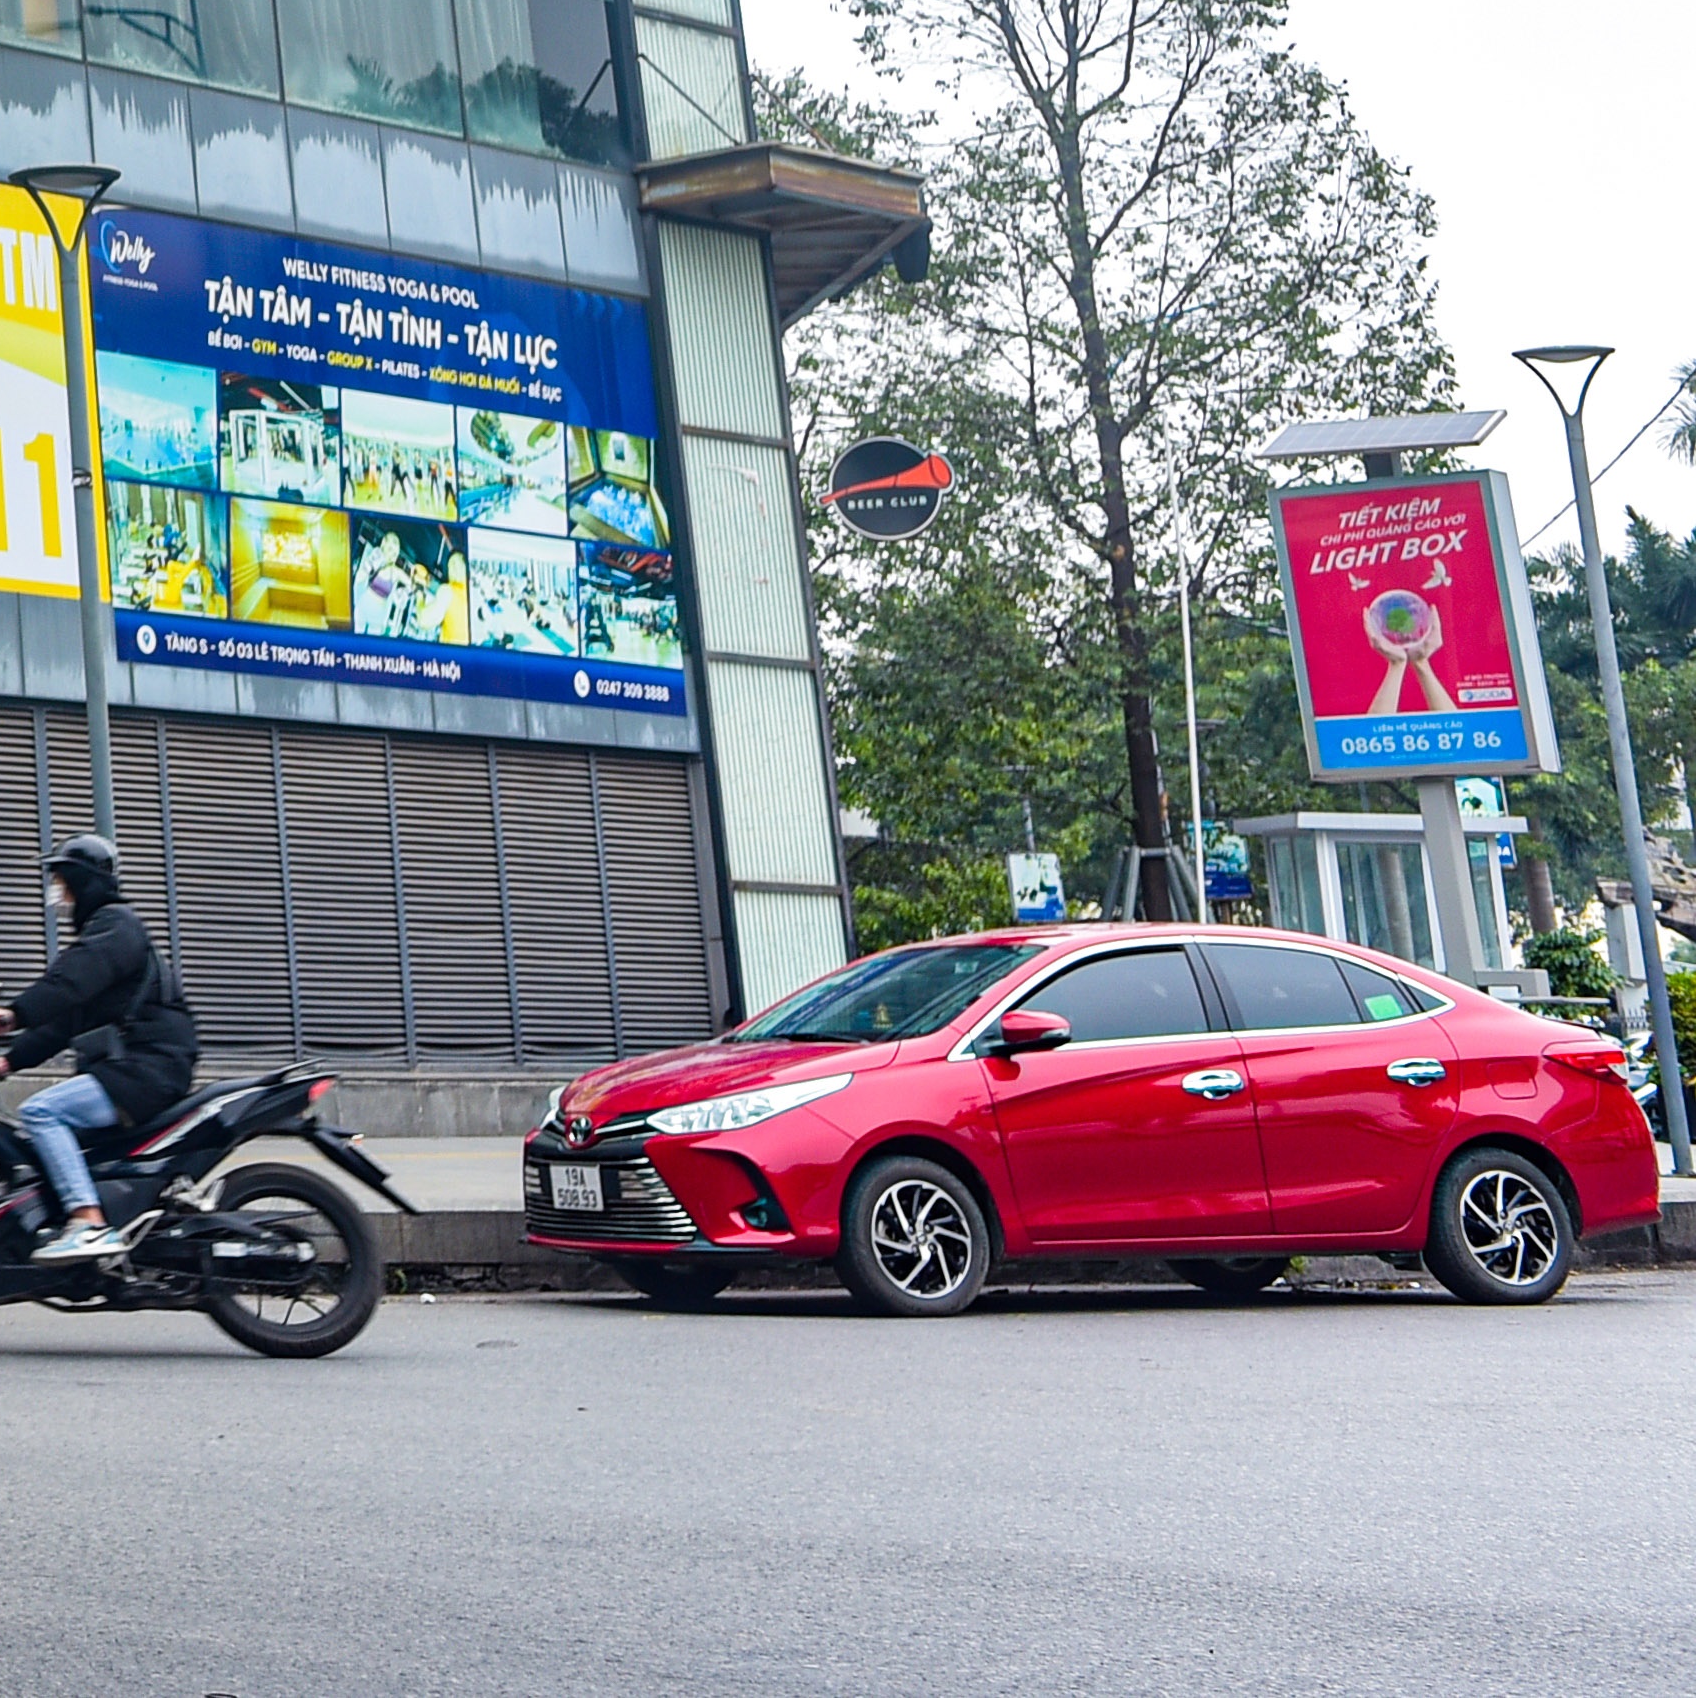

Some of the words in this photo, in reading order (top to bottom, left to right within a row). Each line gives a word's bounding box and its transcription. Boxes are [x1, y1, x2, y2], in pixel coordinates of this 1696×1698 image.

[110, 230, 156, 274] Welly
[282, 256, 328, 283] WELLY
[331, 265, 387, 294] FITNESS
[388, 276, 428, 301] YOGA
[430, 283, 440, 303] &
[441, 285, 479, 310] POOL
[204, 275, 254, 324] TẬN
[259, 284, 311, 329] TÂM
[317, 312, 331, 323] -
[335, 298, 383, 346] TẬN
[388, 305, 442, 350] TÌNH
[447, 333, 459, 344] -
[464, 319, 509, 367] TẬN
[514, 332, 558, 376] LỰC
[252, 337, 277, 357] GYM
[286, 343, 318, 363] YOGA
[327, 350, 364, 370] GROUP
[382, 358, 420, 380] PILATES
[847, 498, 884, 510] BEER
[890, 494, 928, 508] CLUB
[1338, 501, 1383, 530] TIẾT
[1384, 496, 1441, 524] KIỆM
[1310, 540, 1398, 575] LIGHT
[1400, 528, 1468, 561] BOX
[1320, 533, 1341, 547] CHI
[1343, 528, 1365, 543] PHÍ
[1414, 516, 1441, 532] CÁO
[165, 630, 197, 654] TẦNG
[218, 637, 236, 658] SỐ
[237, 642, 253, 659] 03
[254, 640, 269, 661] LÊ
[270, 645, 310, 668] TRỌNG
[343, 652, 383, 673] THANH
[384, 654, 415, 676] XUÂN
[423, 658, 440, 679] HÀ
[441, 660, 461, 683] NỘI
[1341, 736, 1396, 755] 0865
[1402, 734, 1430, 752] 86
[1438, 732, 1464, 750] 87
[1472, 730, 1501, 749] 86
[565, 1166, 587, 1188] 19A
